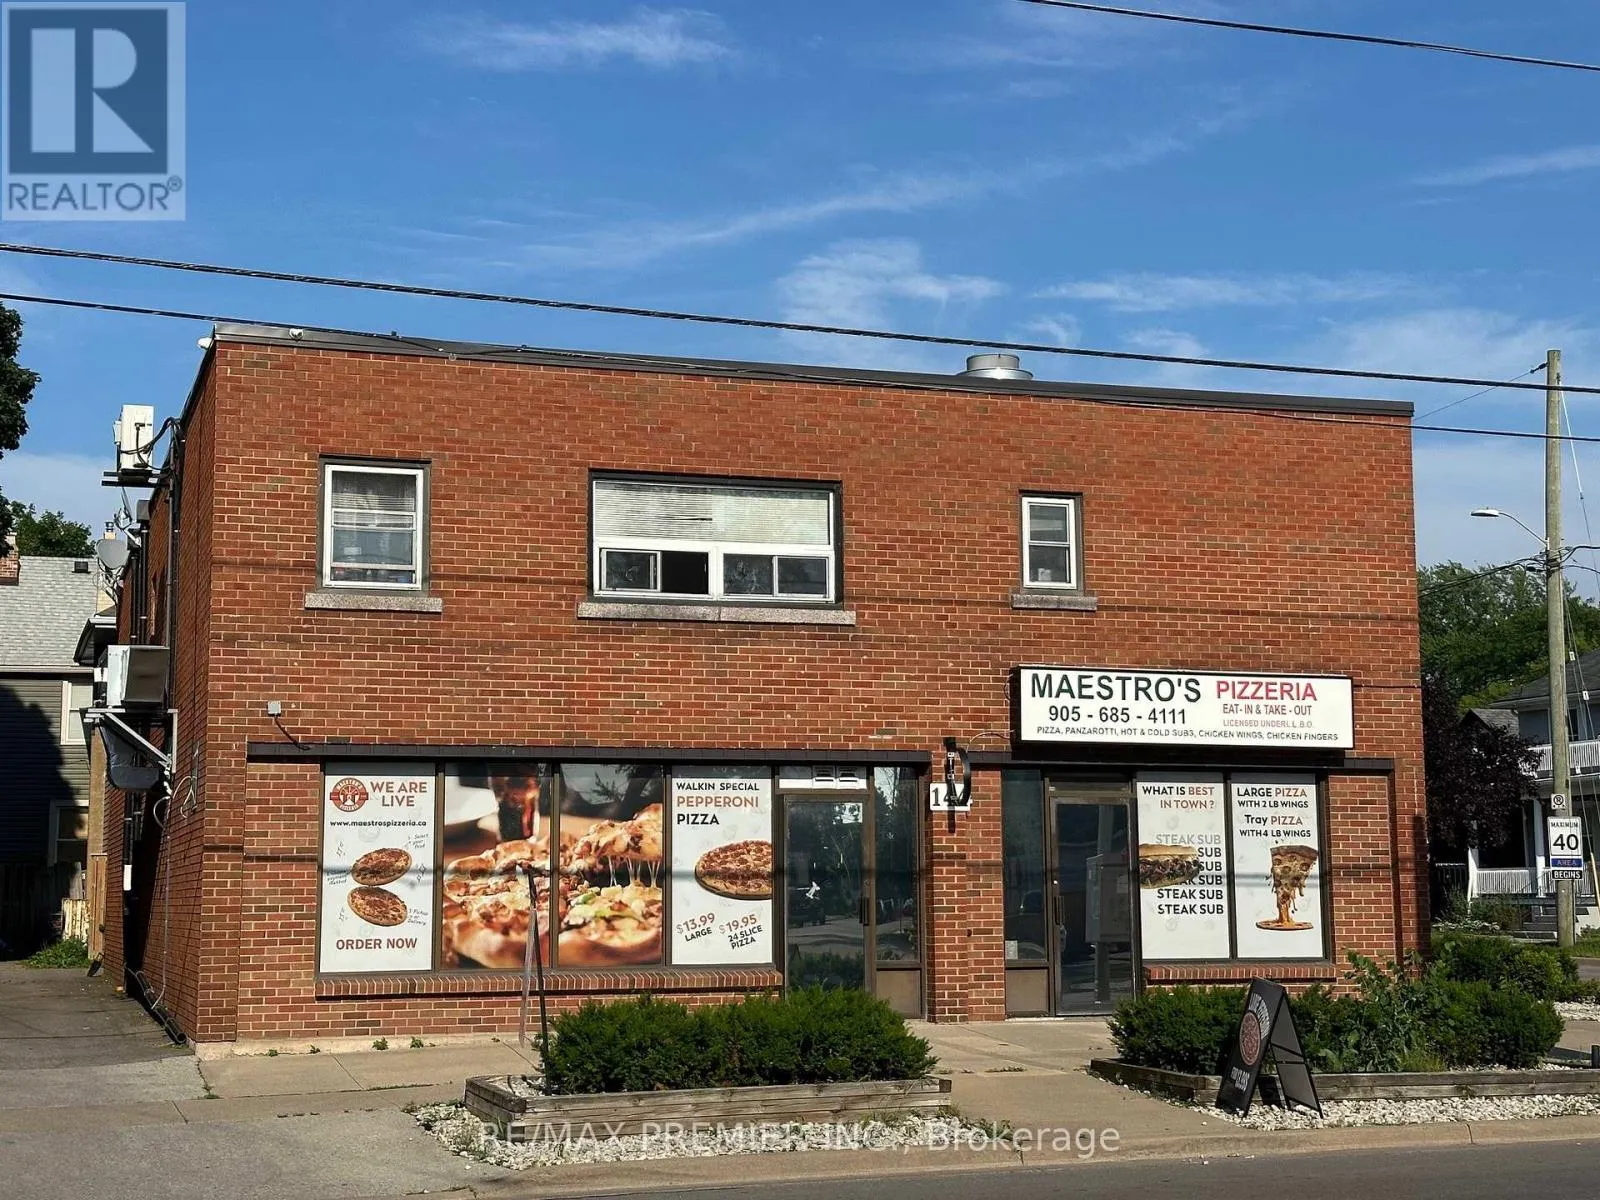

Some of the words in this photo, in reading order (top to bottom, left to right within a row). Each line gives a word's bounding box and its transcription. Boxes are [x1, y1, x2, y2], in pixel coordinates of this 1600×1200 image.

[1031, 673, 1201, 703] MAESTRO'S
[1216, 680, 1318, 701] PIZZERIA
[1048, 705, 1081, 722] 905
[1099, 707, 1130, 723] 685
[1148, 708, 1186, 724] 4111
[1255, 704, 1262, 715] &
[1265, 705, 1287, 715] TAKE
[1294, 705, 1312, 716] OUT
[1223, 719, 1259, 728] LICENSED
[1121, 728, 1137, 736] HOT
[1140, 728, 1146, 736] &
[1148, 729, 1170, 737] COLD
[1198, 730, 1234, 738] CHICKEN
[1267, 731, 1302, 740] CHICKEN
[1304, 732, 1339, 741] FINGERS
[370, 781, 394, 793] WE
[398, 781, 428, 793] ARE
[676, 782, 715, 791] WALKIN
[720, 782, 760, 791] SPECIAL
[1142, 786, 1174, 795] WHAT
[1177, 786, 1186, 795] IS
[1188, 786, 1215, 796] BEST
[1237, 787, 1272, 797] LARGE
[1275, 787, 1308, 797] PIZZA
[382, 795, 415, 807] LIVE
[677, 796, 759, 807] PEPPERONI
[1160, 800, 1172, 809] IN
[1174, 800, 1207, 809] TOWN
[1238, 800, 1260, 808] WITH
[1262, 800, 1267, 808] 2
[1269, 800, 1279, 808] LB
[1280, 800, 1309, 808] WINGS
[329, 819, 427, 828] www.maestrospizzeria.ca
[677, 813, 720, 825] PIZZA
[1244, 814, 1268, 826] Tray
[1271, 815, 1303, 825] PIZZA
[1240, 829, 1261, 837] WITH
[1263, 829, 1269, 837] 4
[1271, 829, 1281, 837] LB
[1283, 829, 1311, 837] WINGS
[1155, 834, 1195, 844] STEAK
[1197, 834, 1222, 845] SUB
[1552, 833, 1579, 851] 40
[1197, 847, 1222, 858] SUB
[1199, 861, 1223, 871] SUB
[1198, 875, 1223, 886] SUB
[1554, 870, 1580, 879] BEGINS
[1157, 888, 1196, 899] STEAK
[1199, 889, 1223, 900] SUB
[1158, 904, 1197, 915] STEAK
[1200, 904, 1224, 915] SUB
[676, 912, 715, 934] $13.99
[719, 914, 757, 934] $19.95
[685, 926, 713, 942] LARGE
[727, 932, 739, 942] 24
[739, 925, 763, 938] SLICE
[336, 939, 382, 950] ORDER
[387, 938, 417, 949] NOW
[731, 936, 756, 949] PIZZA
